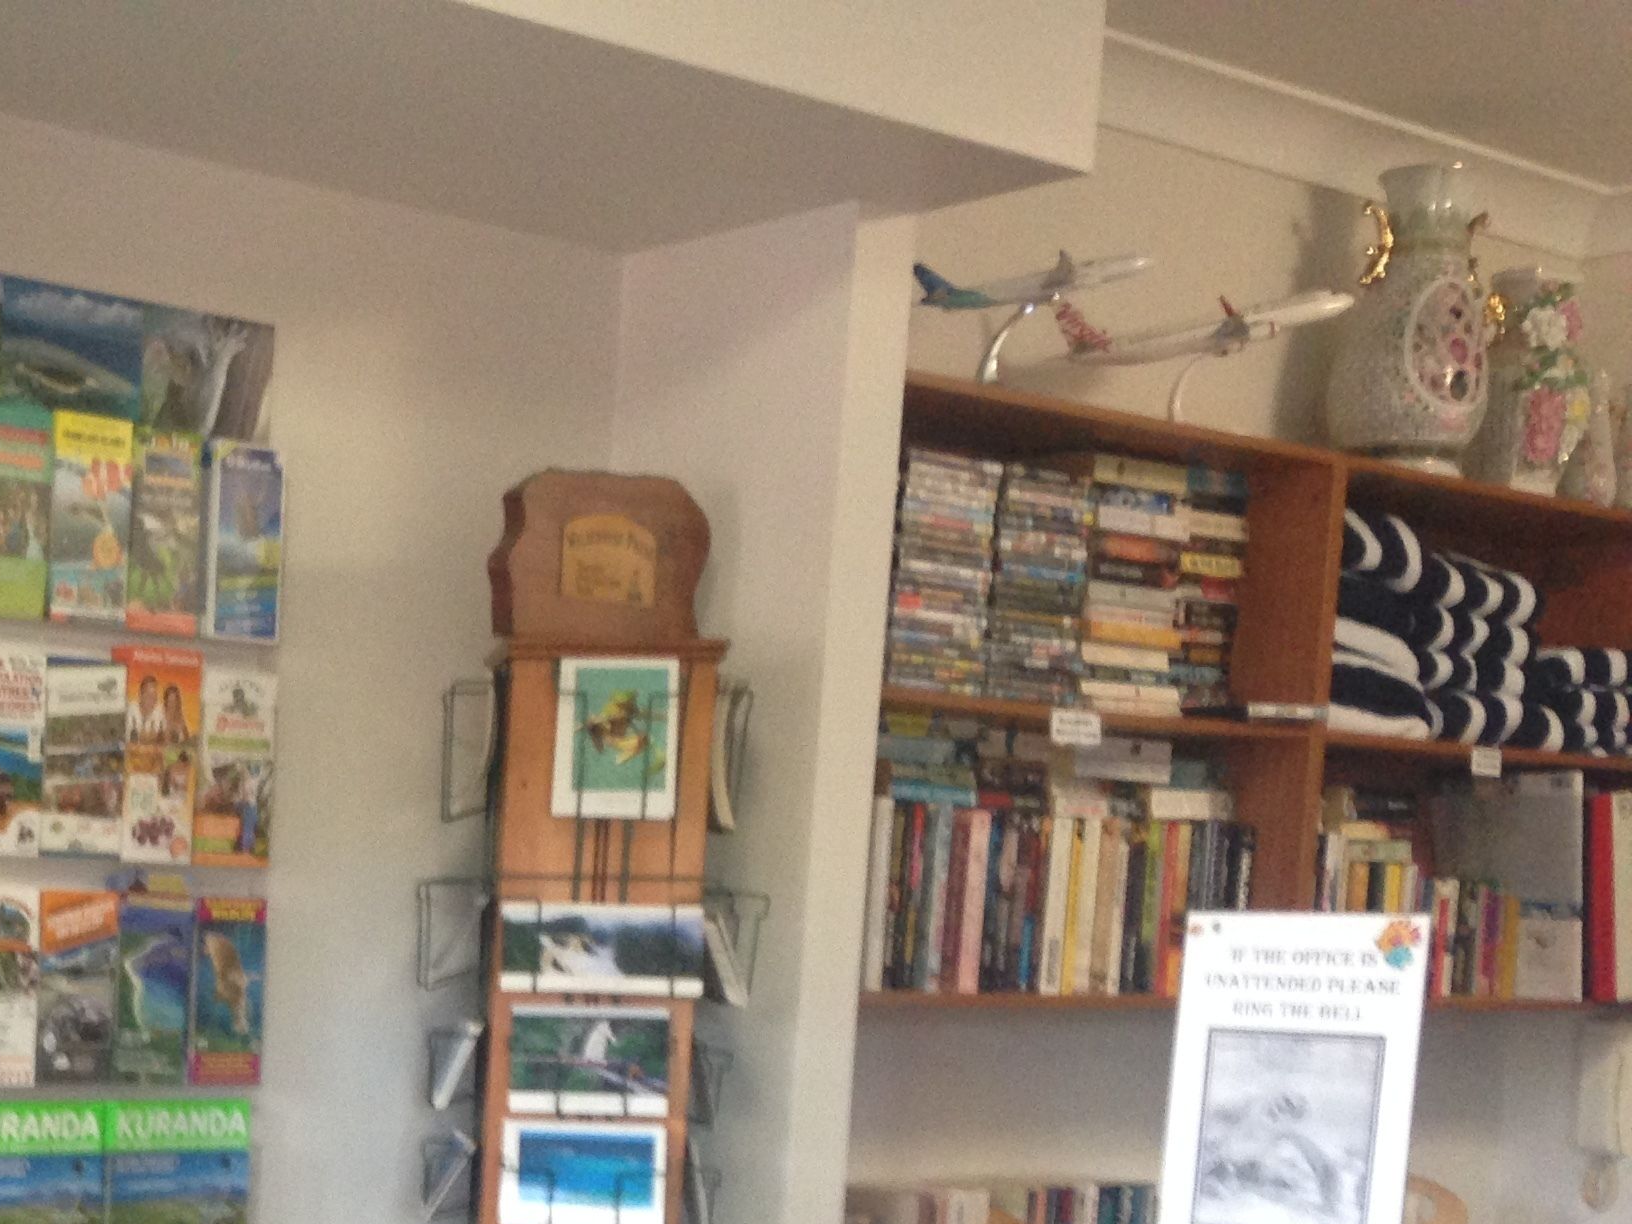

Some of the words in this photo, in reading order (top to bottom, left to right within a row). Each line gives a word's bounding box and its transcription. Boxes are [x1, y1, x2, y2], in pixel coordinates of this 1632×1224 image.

[1231, 948, 1246, 963] IF
[1252, 948, 1287, 965] THE
[1291, 950, 1356, 967] OFFICE
[1361, 951, 1378, 968] IS
[1205, 971, 1321, 993] UNATTENDED
[1326, 976, 1401, 996] PLEASE
[1232, 1000, 1274, 1018] RING
[1279, 1002, 1311, 1019] THE
[1318, 1004, 1362, 1021] BELL
[116, 1109, 249, 1142] KURANDA
